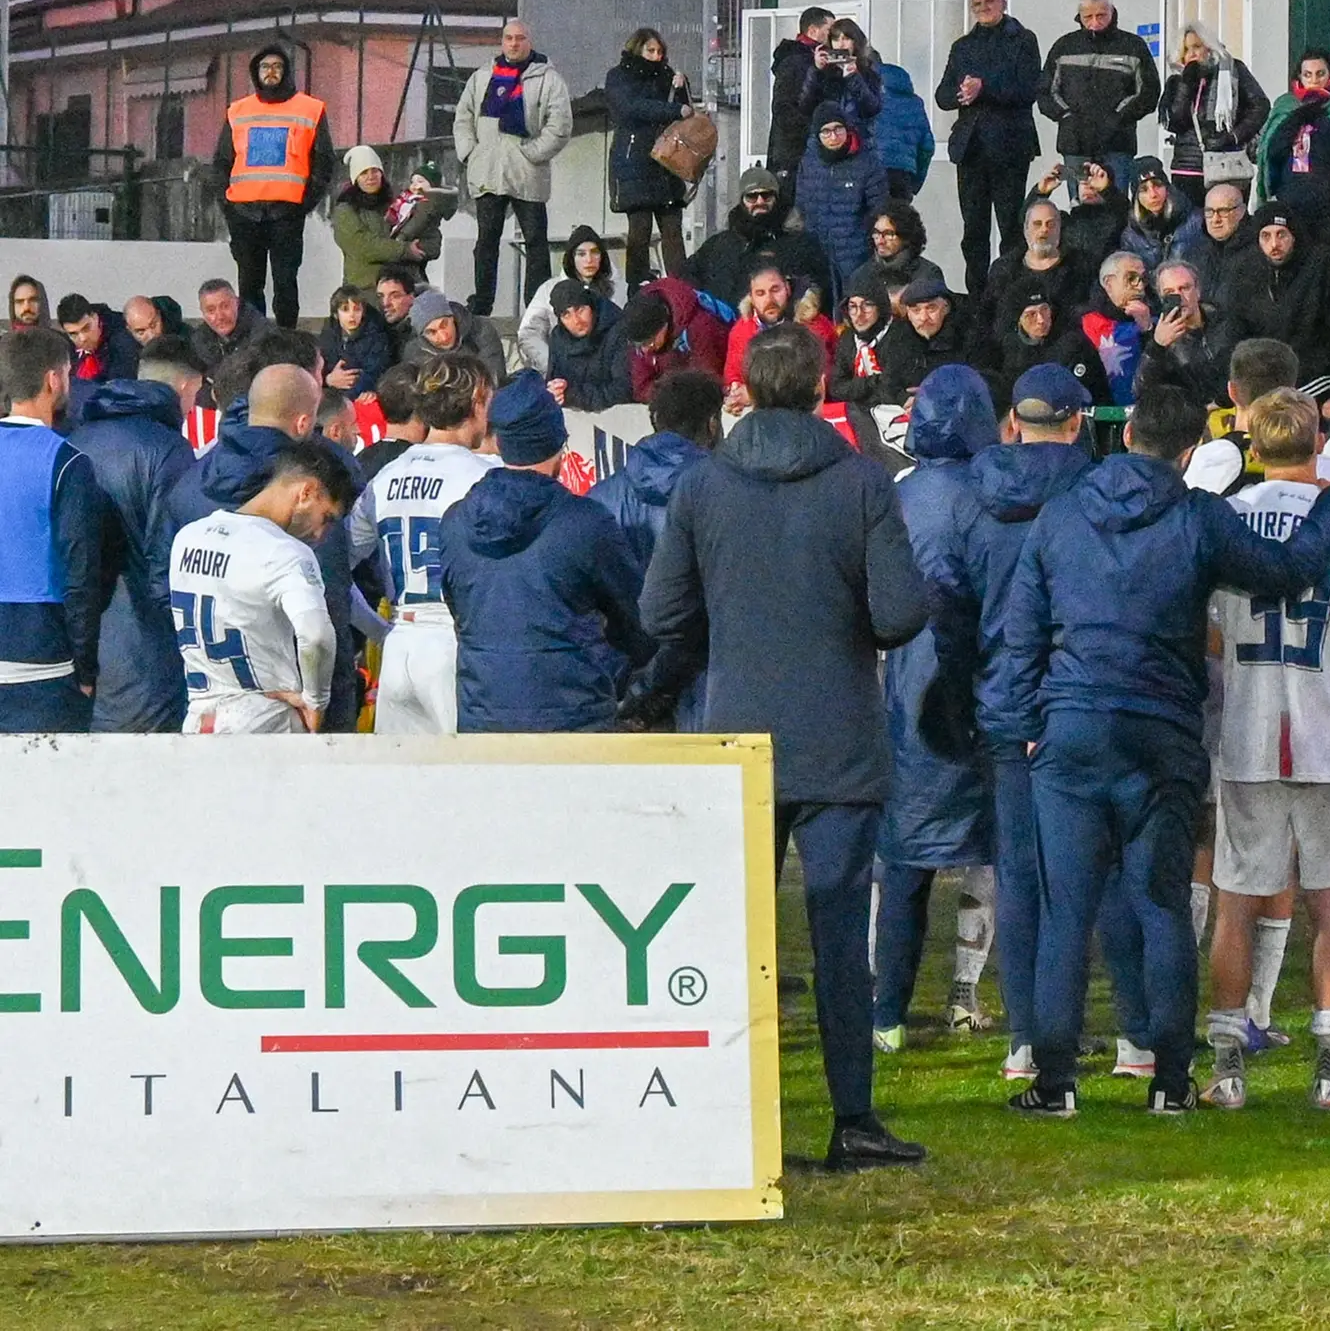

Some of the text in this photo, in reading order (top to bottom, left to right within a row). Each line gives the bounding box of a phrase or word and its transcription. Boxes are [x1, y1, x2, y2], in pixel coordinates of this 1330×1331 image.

[386, 476, 444, 501] CIERVO
[179, 546, 232, 579] MAURI
[171, 589, 264, 693] 24
[63, 1066, 678, 1117] ITALIANA
